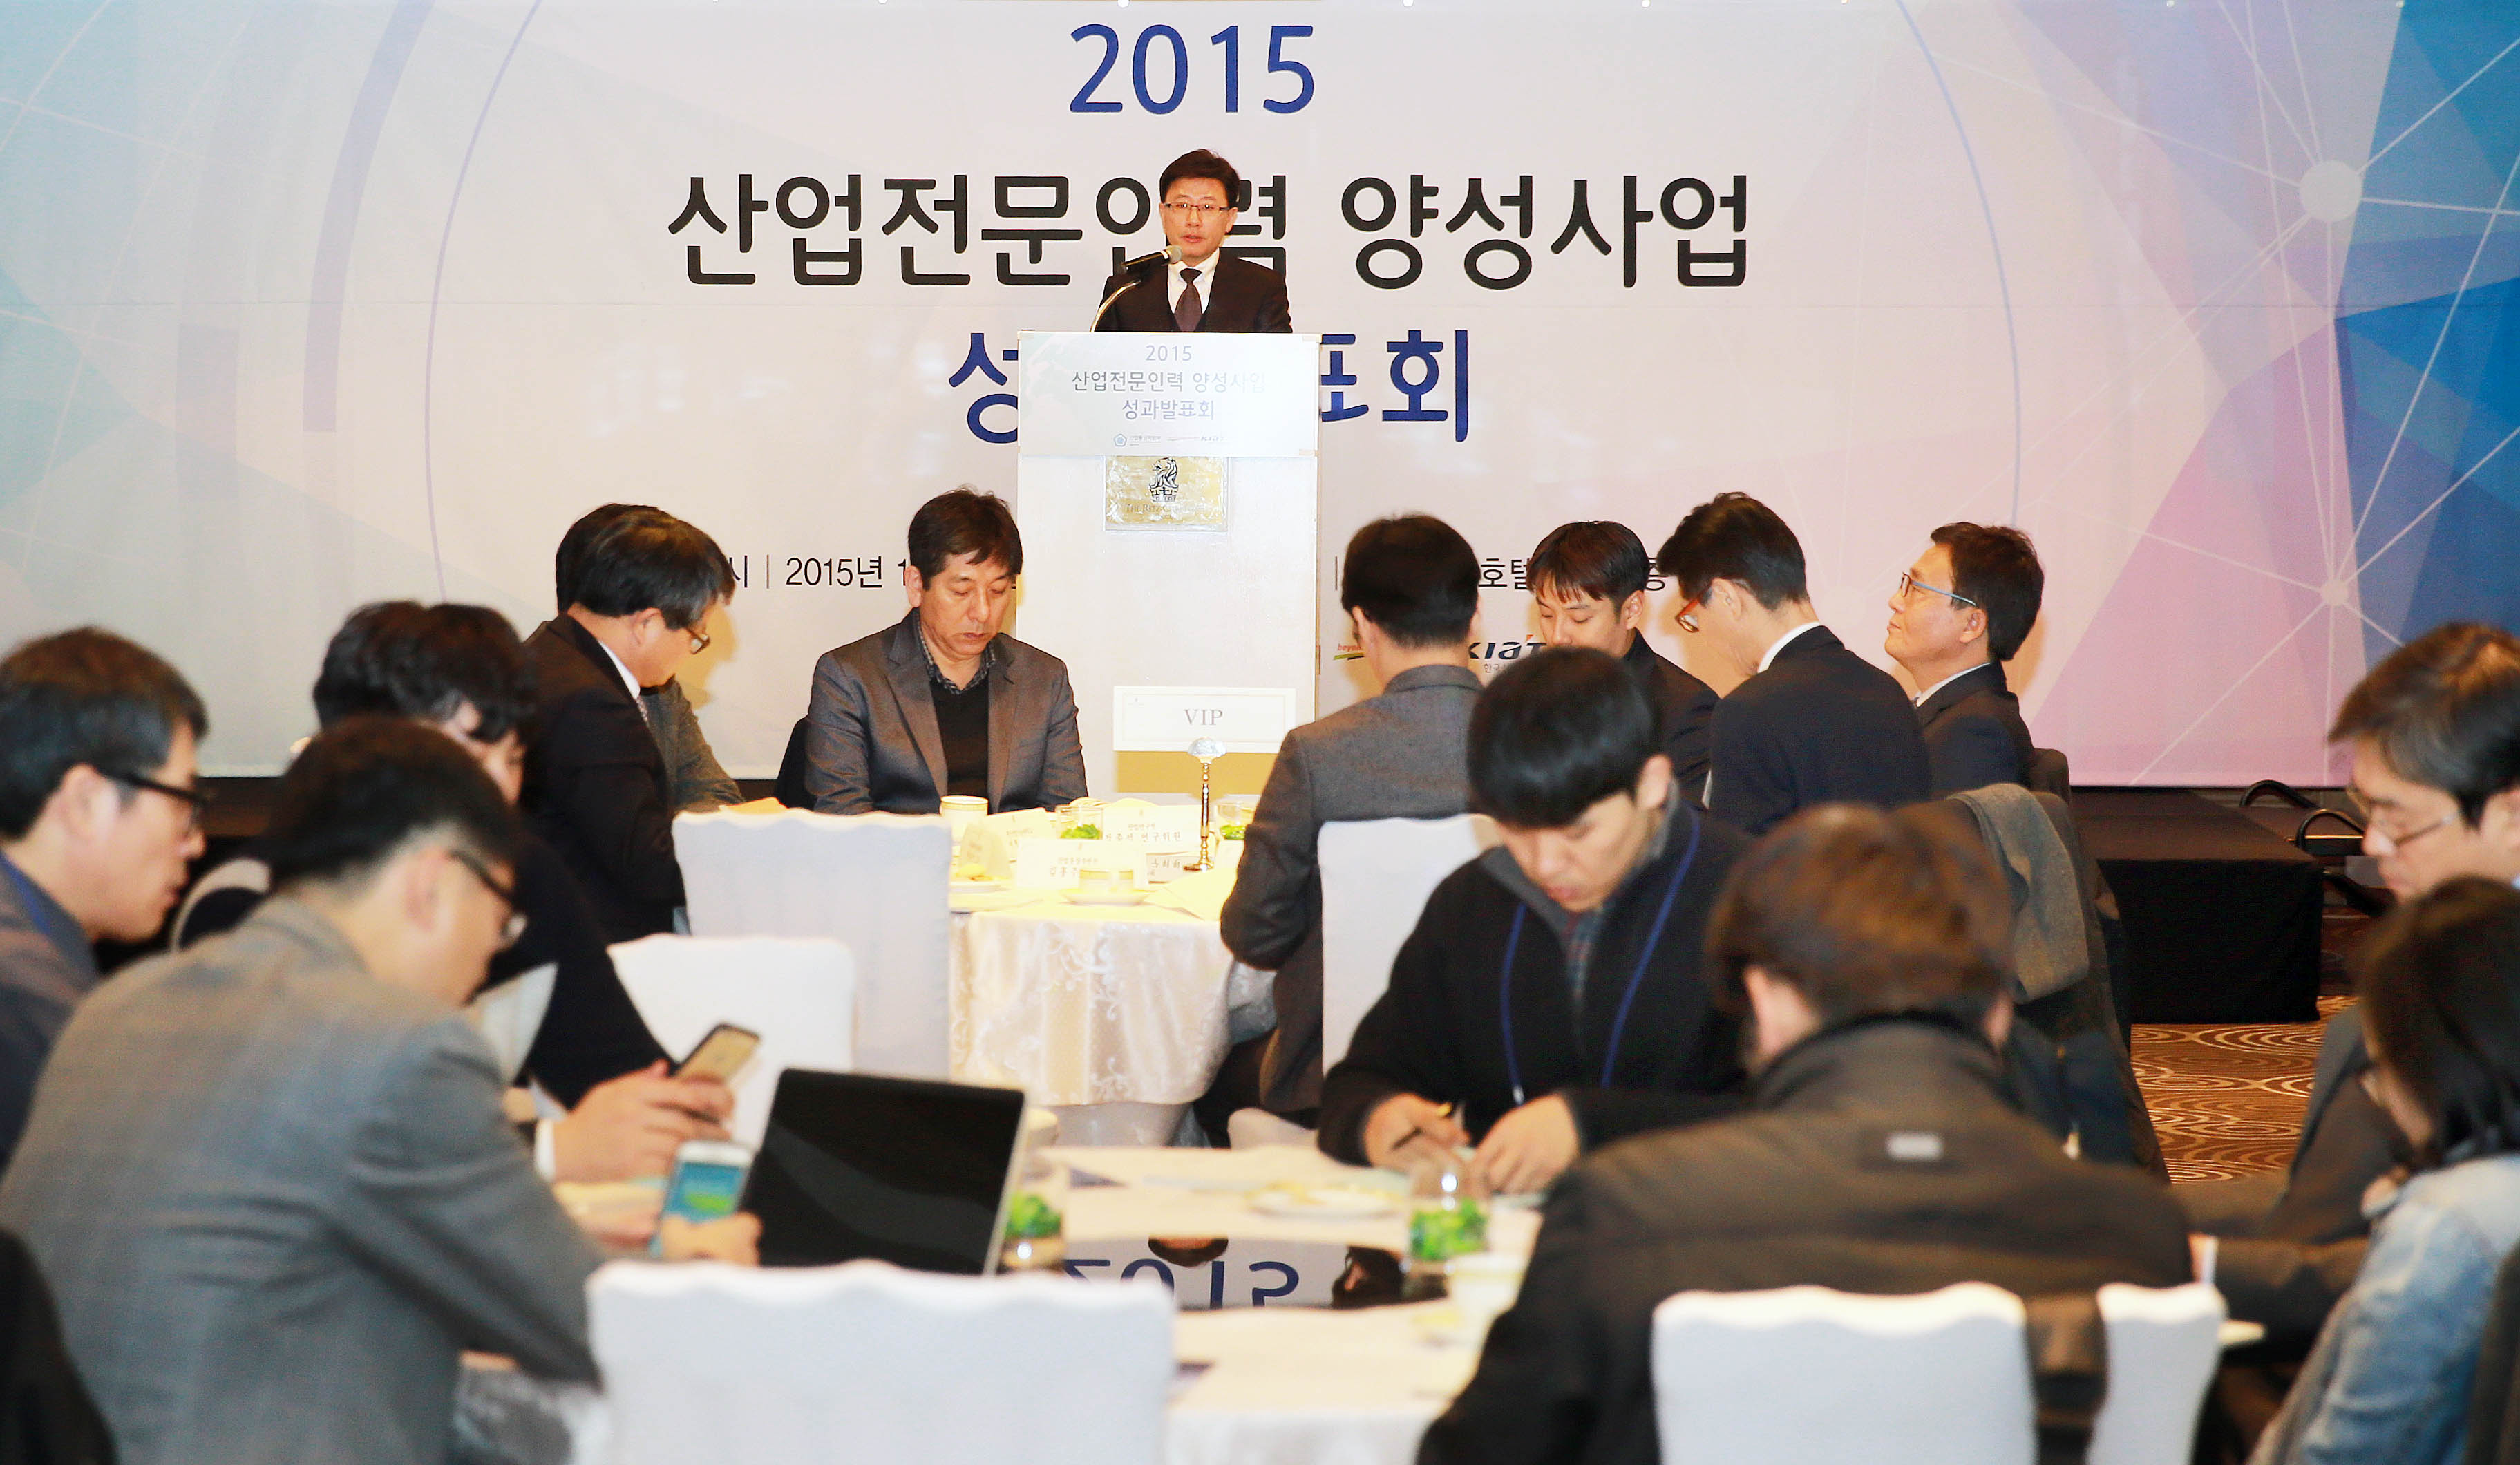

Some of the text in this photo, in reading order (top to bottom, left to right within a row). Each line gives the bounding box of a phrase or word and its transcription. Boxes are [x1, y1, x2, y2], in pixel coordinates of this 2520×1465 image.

[1070, 24, 1314, 115] 2015
[1341, 174, 1747, 290] 양성사업
[1146, 345, 1193, 361] 2015
[1072, 371, 1184, 392] 산업전문인력
[1122, 399, 1215, 420] 성과발표회
[786, 556, 882, 588] 2015년
[1184, 709, 1223, 726] VIP
